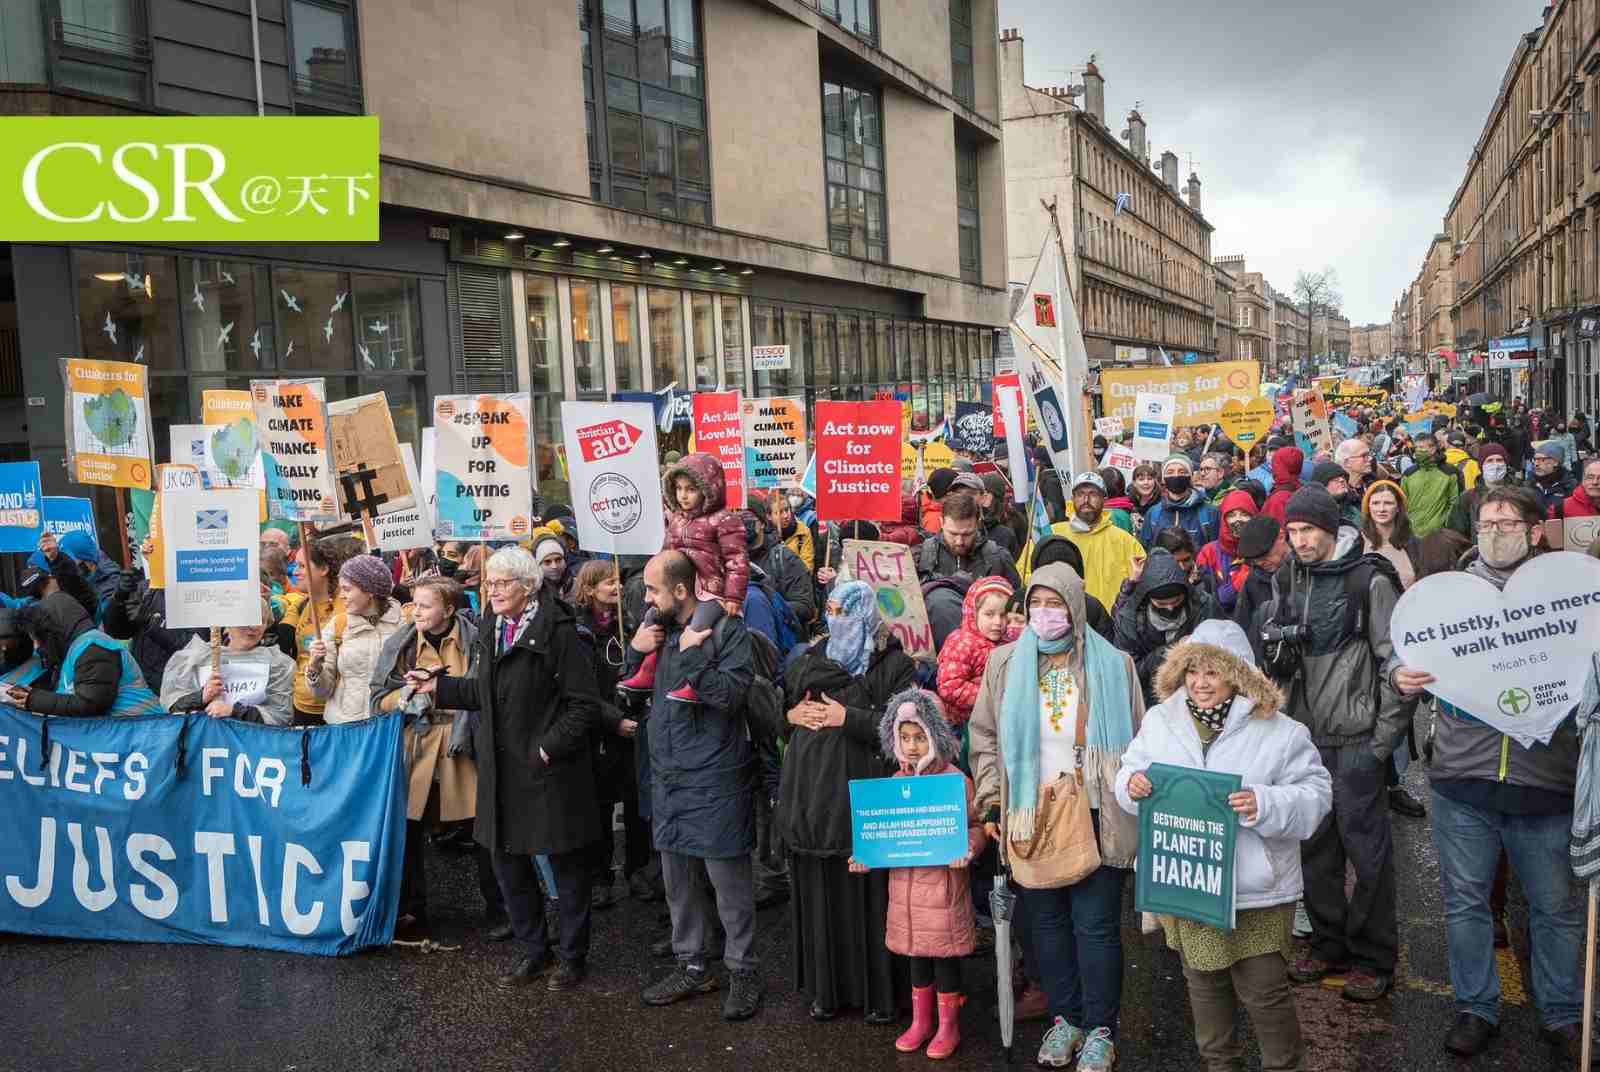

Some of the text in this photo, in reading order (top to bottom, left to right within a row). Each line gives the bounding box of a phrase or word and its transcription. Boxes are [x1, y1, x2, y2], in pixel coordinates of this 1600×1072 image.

[1110, 381, 1189, 398] Quakers
[1195, 376, 1222, 391] for
[273, 394, 303, 408] MAKE
[702, 411, 720, 424] Act
[759, 407, 787, 416] MAKE
[268, 418, 314, 431] CLIMATE
[754, 421, 795, 431] CLIMATE
[823, 420, 895, 436] Act now
[471, 436, 491, 449] UP
[592, 422, 634, 459] aid
[697, 430, 724, 441] Love
[754, 437, 796, 447] FINANCE
[270, 441, 318, 455] FINANCE
[846, 440, 871, 455] for
[755, 452, 796, 461] LEGALLY
[275, 464, 318, 478] LEGALLY
[468, 460, 496, 473] FOR
[754, 467, 796, 477] BINDING
[823, 460, 894, 475] Climate
[456, 484, 510, 497] PAYING
[827, 479, 890, 494] Justice
[277, 487, 322, 501] BINDING
[372, 513, 420, 529] for climate
[472, 509, 492, 522] UP
[382, 527, 415, 540] justice!
[856, 550, 906, 582] ACT
[1403, 626, 1437, 646] Act
[1439, 614, 1500, 641] justly,
[1503, 603, 1546, 623] love
[1452, 618, 1578, 658] walk humbly
[1491, 651, 1549, 673] Micah 6:8
[1532, 679, 1567, 693] renew
[1534, 691, 1555, 700] our
[1536, 692, 1569, 707] world
[202, 747, 287, 808] FOR
[1153, 812, 1225, 836] DESTROYING THE
[1153, 830, 1223, 861] PLANET IS
[5, 816, 372, 938] JUSTICE
[1152, 854, 1223, 896] HARAM
